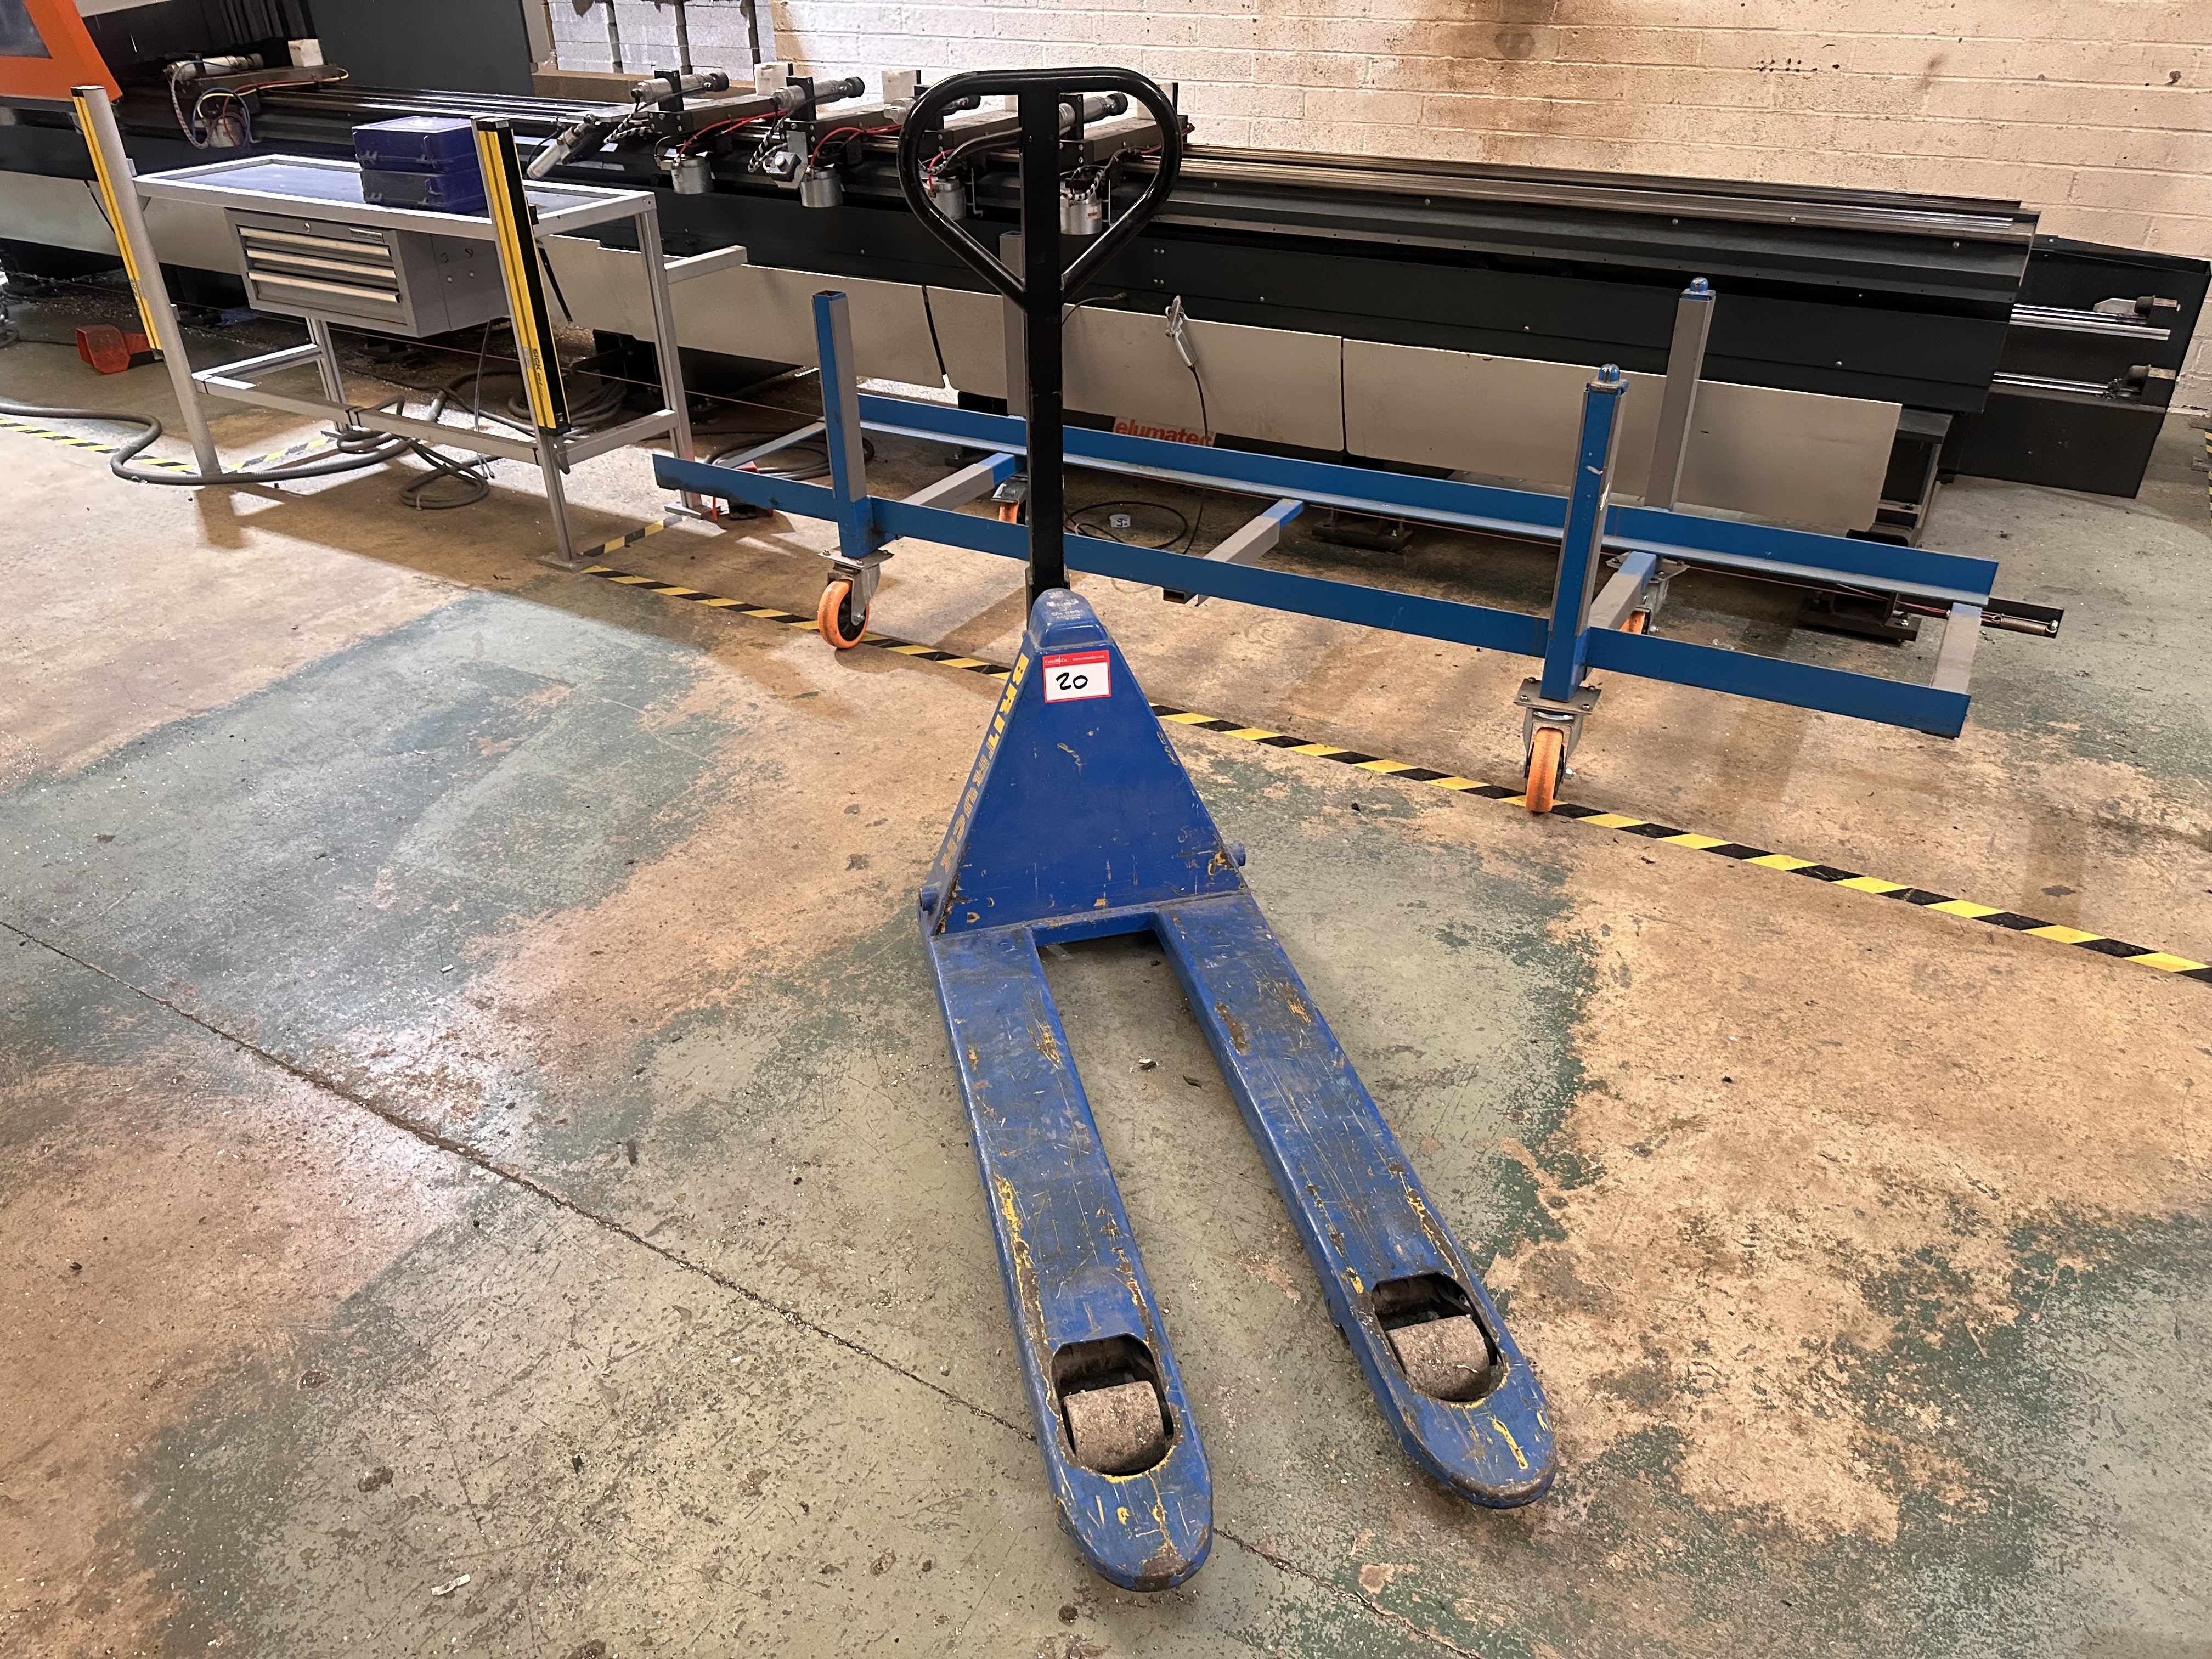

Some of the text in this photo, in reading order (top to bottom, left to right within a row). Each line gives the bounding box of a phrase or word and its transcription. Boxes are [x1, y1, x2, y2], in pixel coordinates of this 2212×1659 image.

[532, 348, 541, 370] SICK
[1115, 419, 1213, 446] elumatec
[1056, 672, 1088, 690] 20
[940, 652, 1029, 875] BRITRUCK
